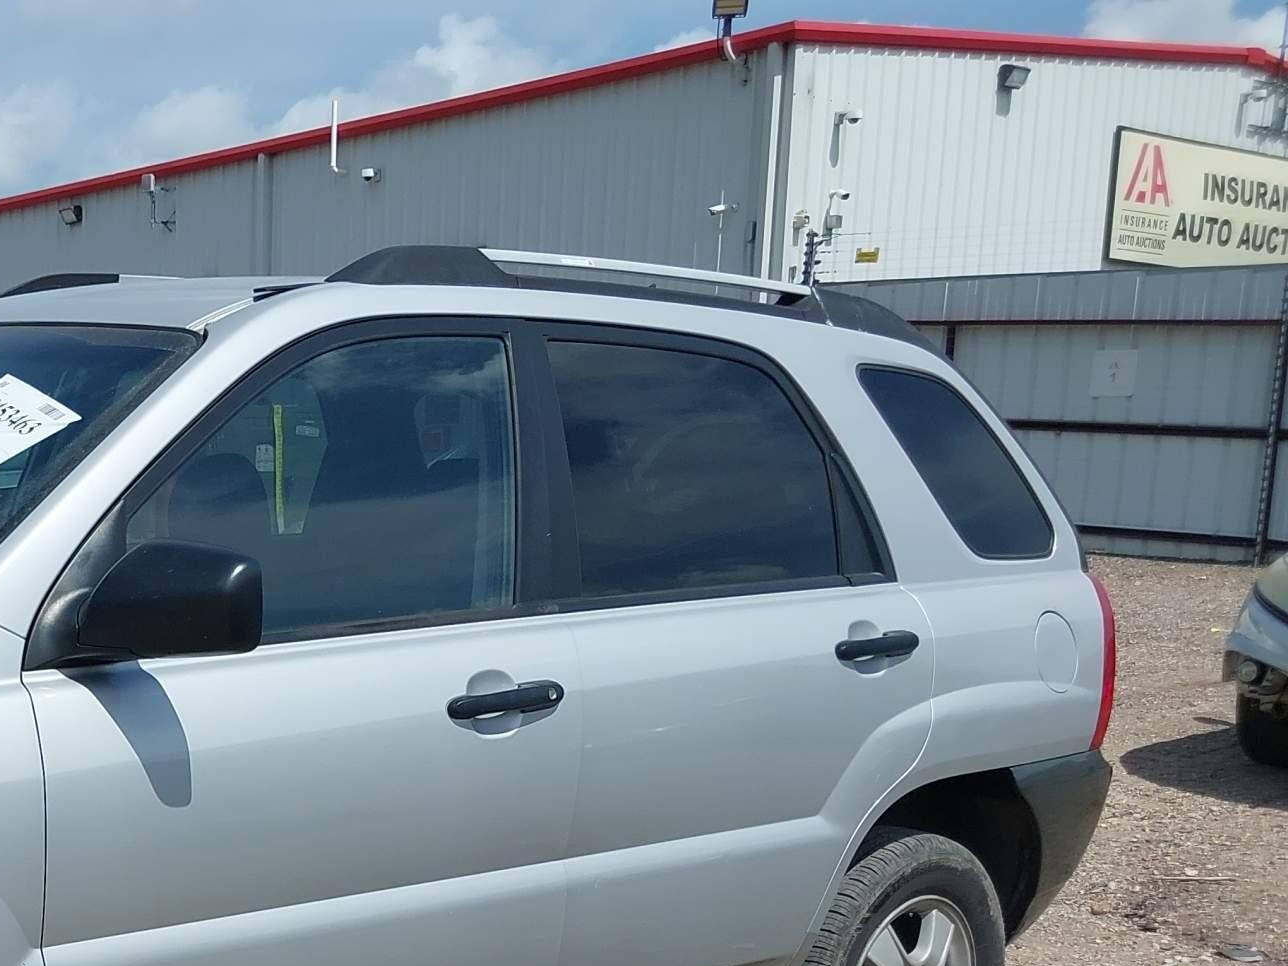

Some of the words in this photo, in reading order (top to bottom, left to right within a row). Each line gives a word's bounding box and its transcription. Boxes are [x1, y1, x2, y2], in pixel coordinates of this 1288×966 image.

[1120, 214, 1168, 231] INSURANCE
[1172, 212, 1232, 247] AUTO
[1117, 234, 1135, 246] AUTO
[1135, 235, 1166, 250] AUCTIONS
